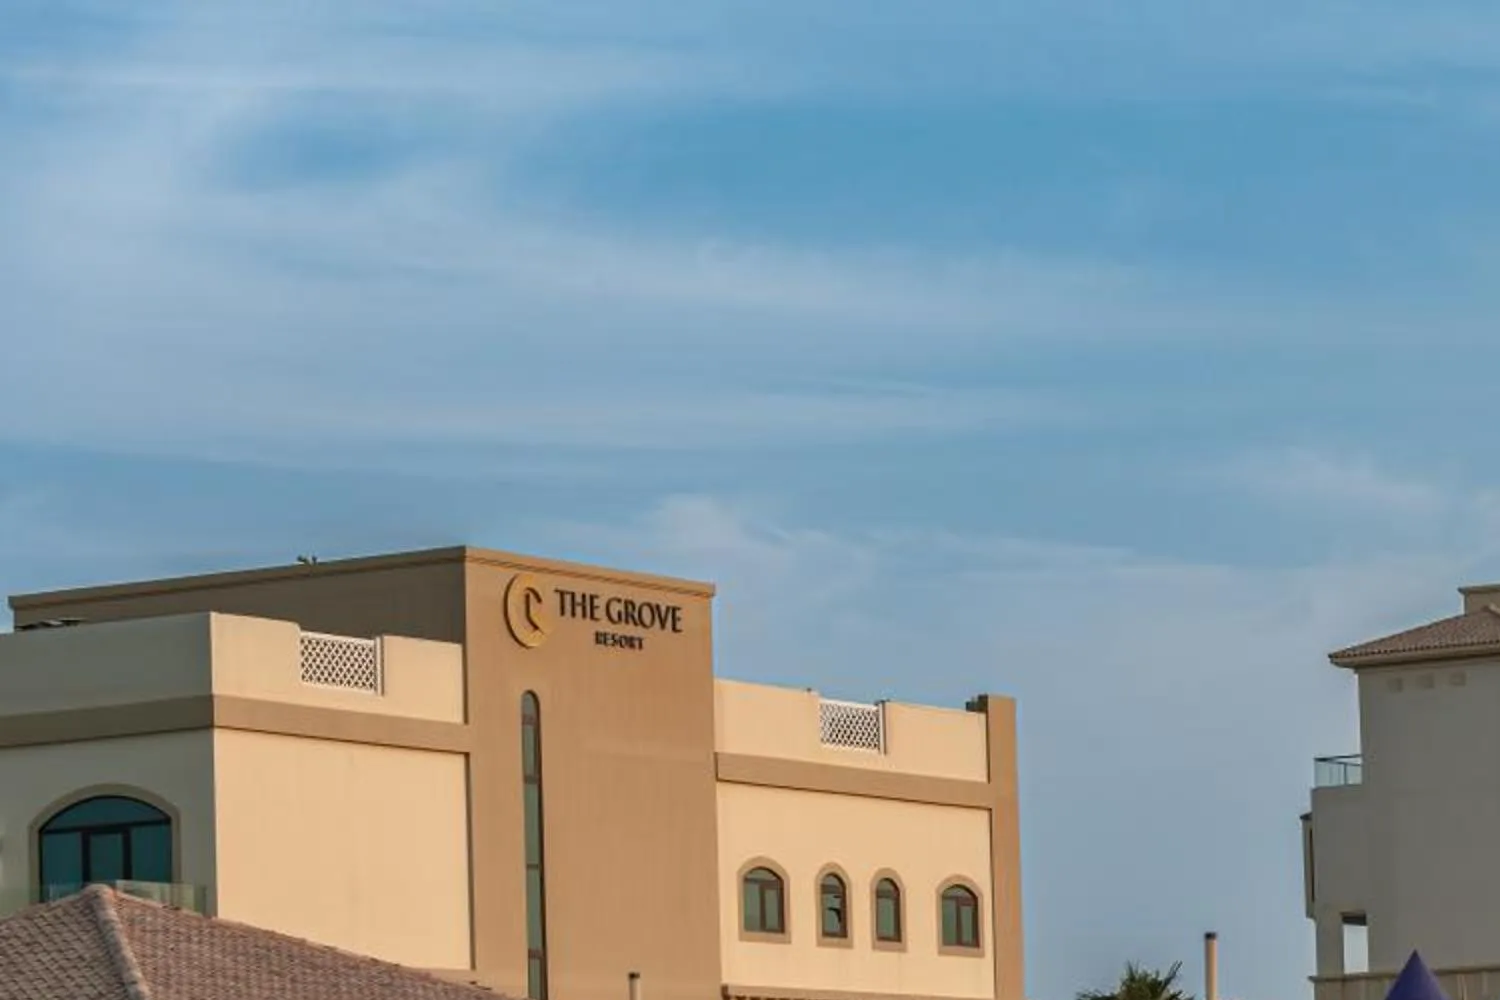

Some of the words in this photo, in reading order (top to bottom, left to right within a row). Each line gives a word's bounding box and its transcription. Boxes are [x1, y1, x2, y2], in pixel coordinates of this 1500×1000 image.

[554, 588, 600, 622] THE
[605, 597, 684, 634] GROVE
[594, 630, 644, 651] RESORT
